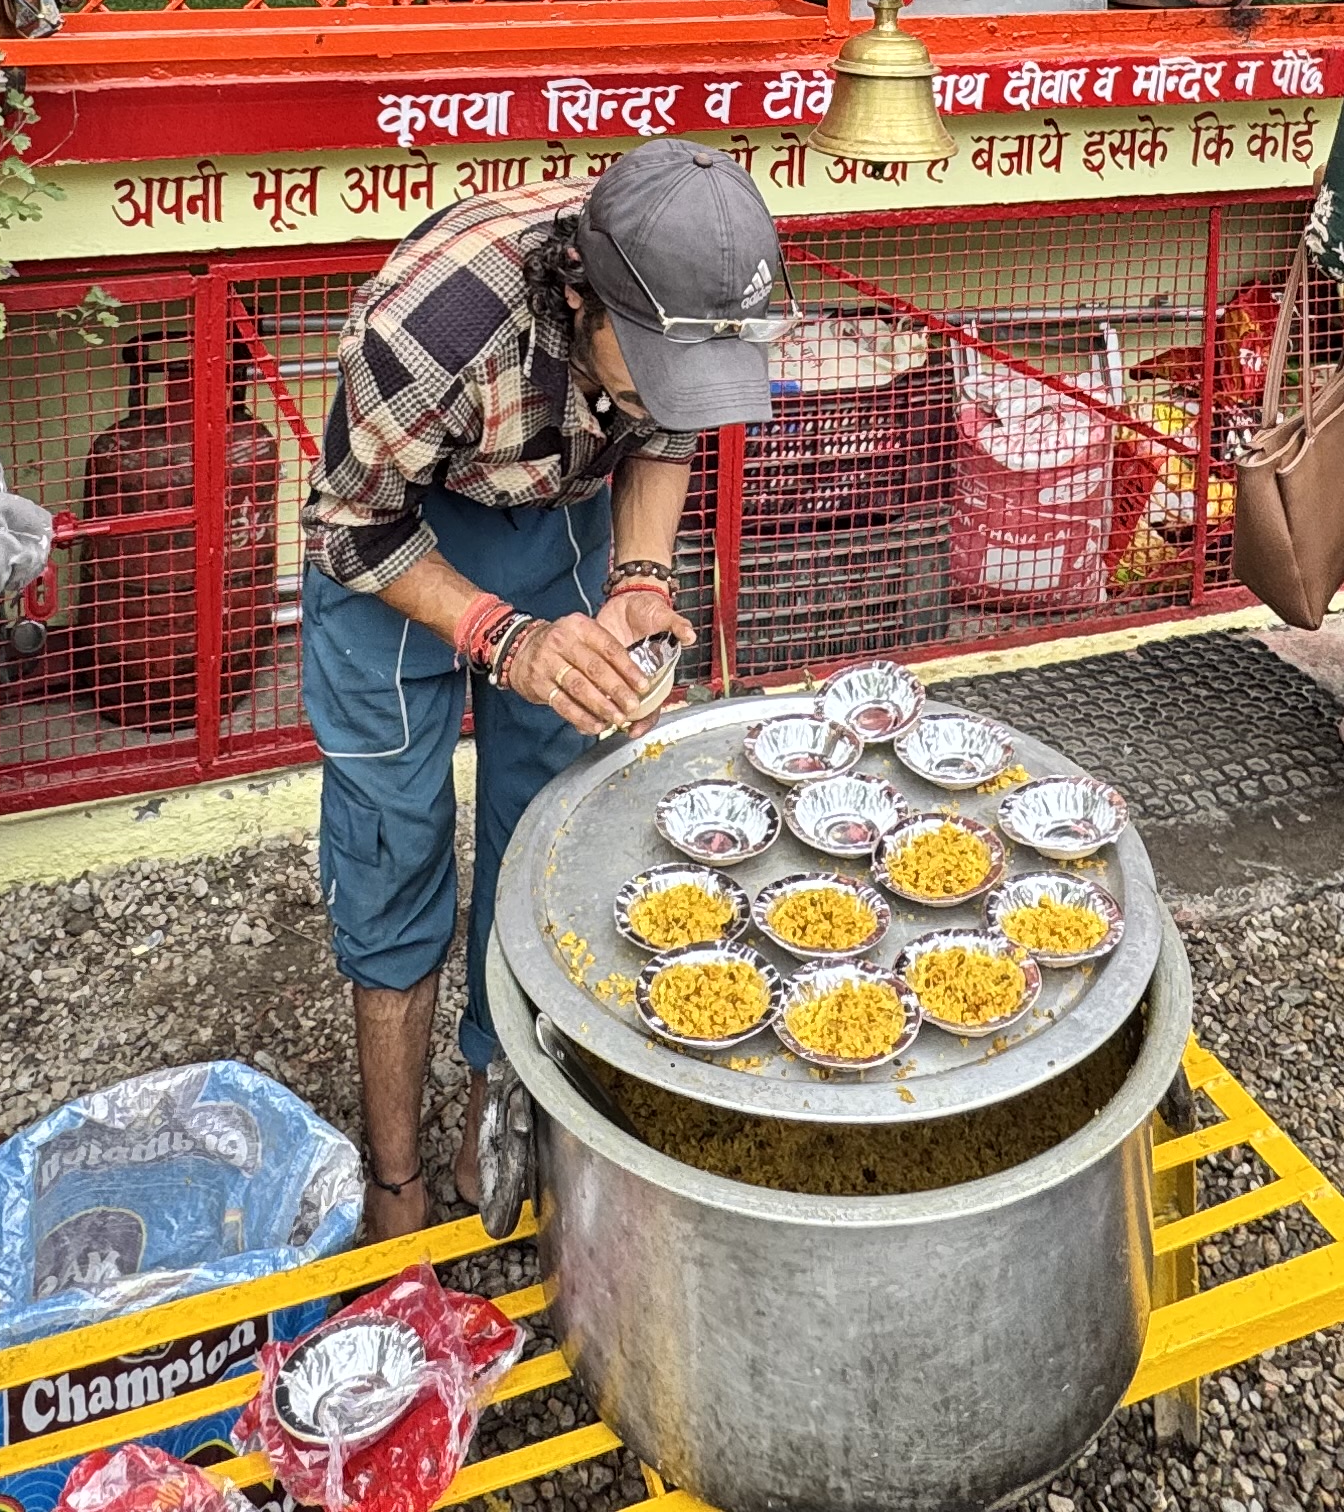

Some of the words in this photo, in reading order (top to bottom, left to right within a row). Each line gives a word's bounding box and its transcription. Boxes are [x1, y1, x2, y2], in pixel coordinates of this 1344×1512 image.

[376, 90, 515, 148] कृपया
[540, 77, 683, 137] सिन्दूर
[703, 81, 743, 125] व
[1003, 60, 1088, 112] दीवार
[1092, 63, 1120, 102] व
[1131, 54, 1227, 104] मन्दिर
[1233, 58, 1260, 97] न
[112, 159, 231, 228] अपनी
[245, 164, 328, 232] भूल
[340, 147, 440, 214] अपने
[970, 117, 1072, 177] बजाये
[1083, 114, 1175, 181] इसके
[1190, 109, 1236, 168] कि
[1246, 104, 1323, 169] कोई
[22, 1319, 257, 1434] Champion
